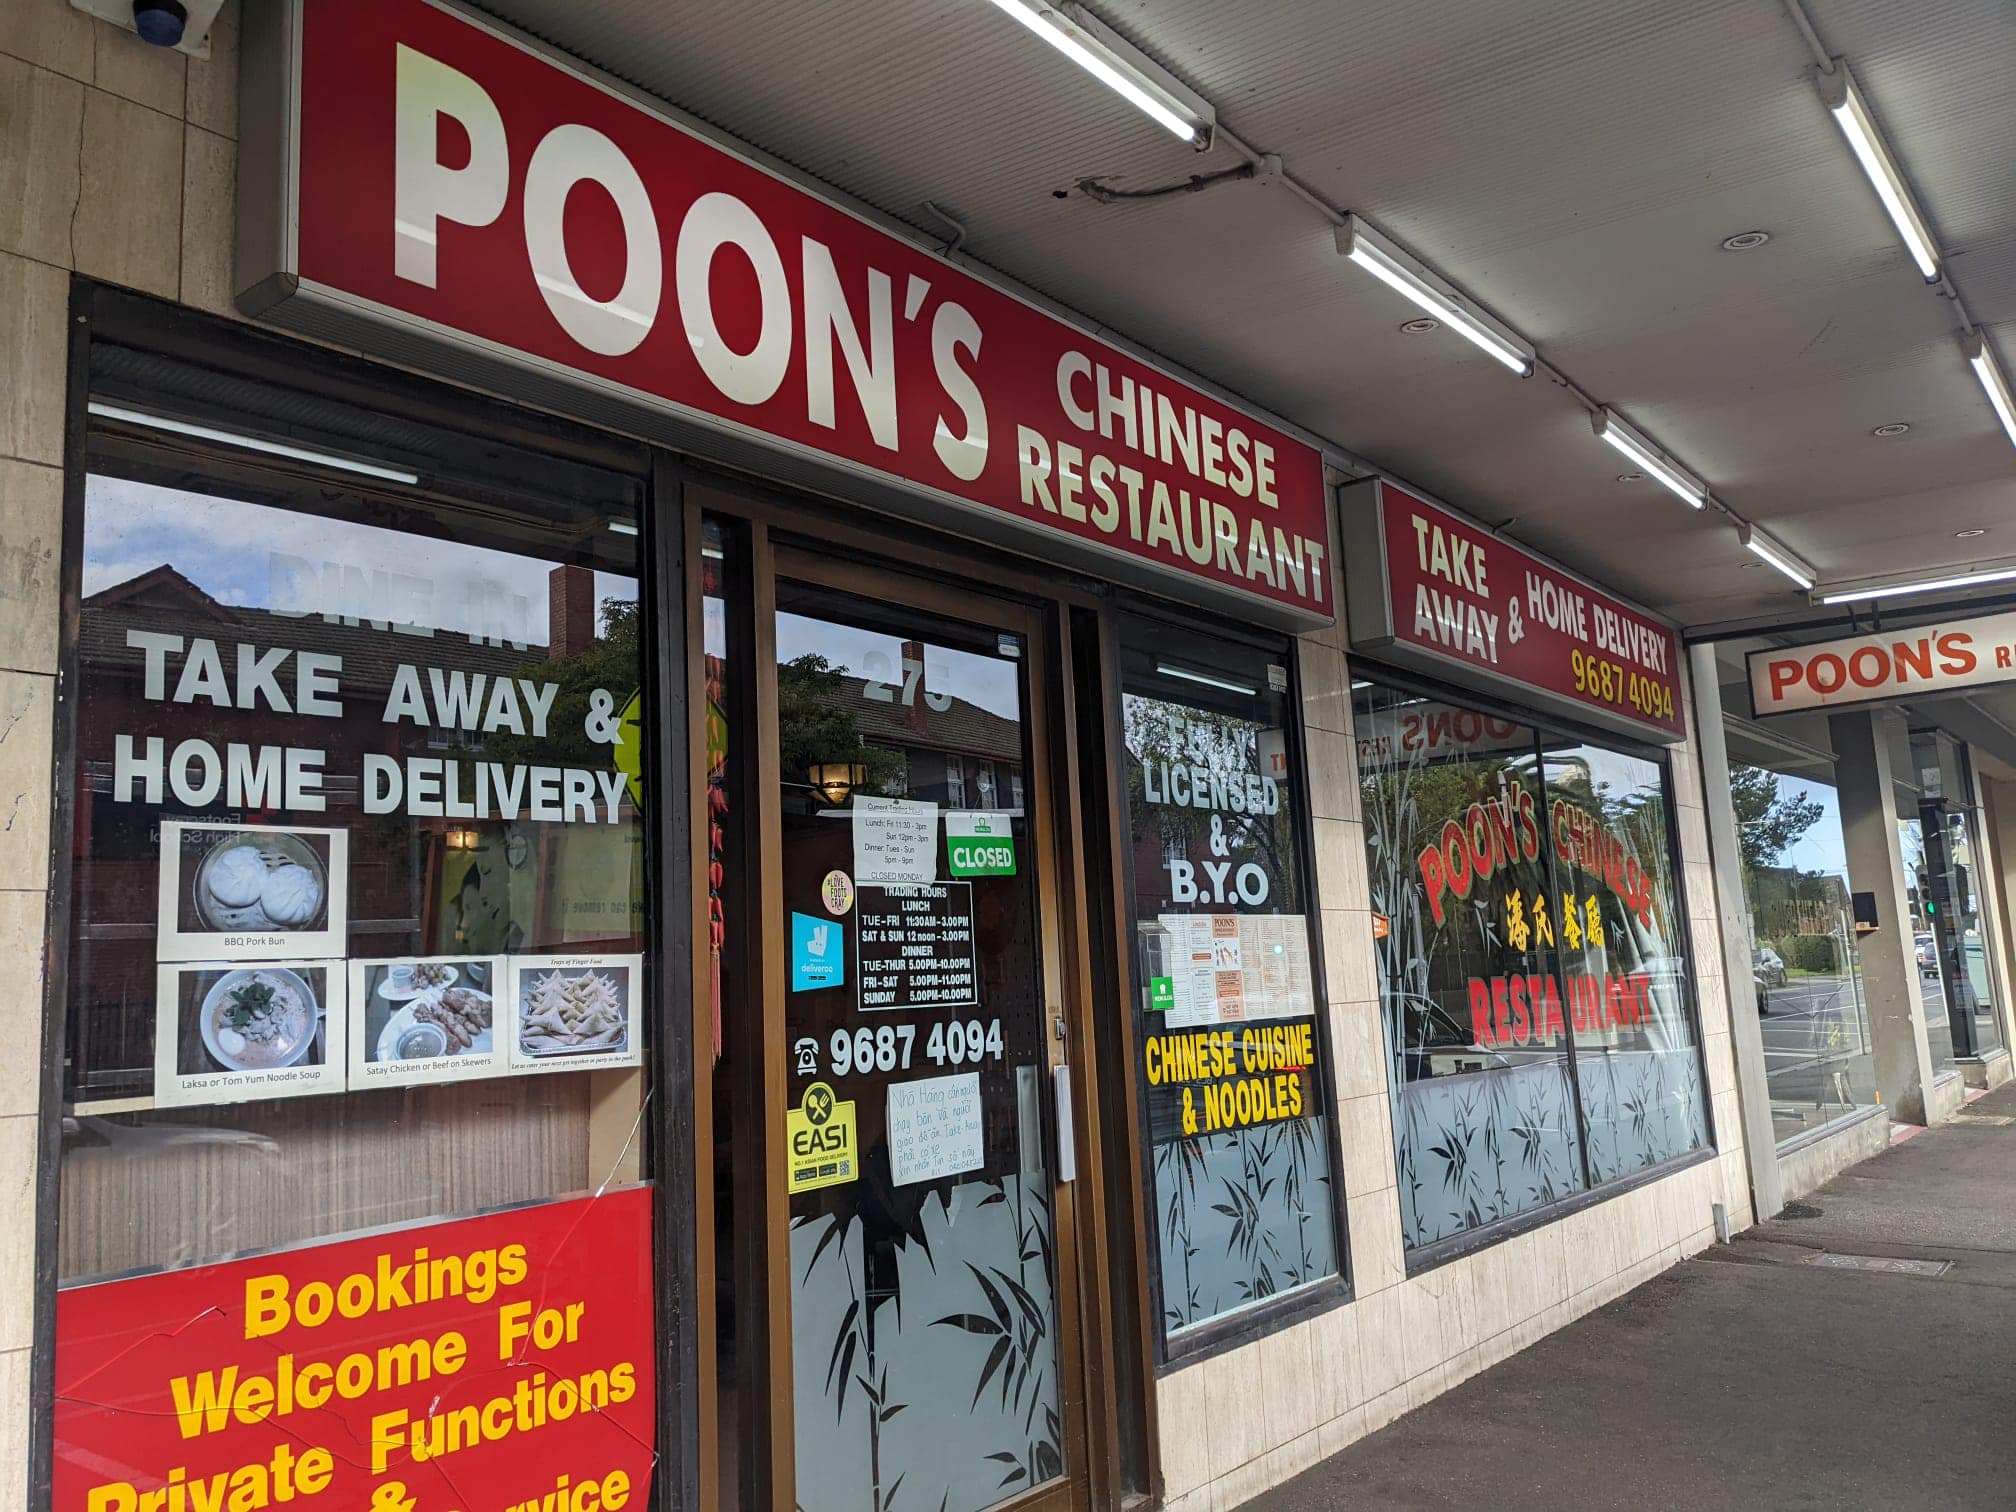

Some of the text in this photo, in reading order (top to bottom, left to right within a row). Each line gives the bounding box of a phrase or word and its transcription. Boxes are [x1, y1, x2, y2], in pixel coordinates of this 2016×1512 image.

[394, 42, 988, 480] POON'S
[1056, 350, 1279, 509] CHINESE
[1017, 424, 1324, 602] RESTAURANT
[1411, 514, 1489, 598] TAKE
[1414, 584, 1525, 664] AWAY &
[1526, 570, 1667, 676] HOME DELIVERY
[126, 629, 625, 745] TAKE AWAY &
[863, 650, 953, 712] 275
[1571, 649, 1675, 722] 9687 4094
[1769, 630, 1977, 700] POON'S
[1169, 717, 1248, 770] FULLY
[114, 734, 628, 825] HOME DELIVERY
[1143, 760, 1280, 816] LICENSED
[953, 847, 1012, 868] CLOSED
[1210, 814, 1230, 857] &
[1418, 781, 1539, 929] POON'S
[1552, 800, 1652, 929] CHINESE
[831, 888, 847, 898] FOOTS
[871, 872, 923, 880] CLOSED MONDAY
[884, 887, 947, 898] TRADING HOURS
[902, 900, 930, 911] LUNCH
[1170, 859, 1269, 906] B.Y.O
[224, 936, 285, 946] BBQ Pork Bun
[862, 931, 878, 942] SAT
[880, 931, 886, 942] &
[888, 931, 905, 942] SUN
[907, 931, 916, 942] 12
[918, 933, 936, 942] noon
[902, 945, 934, 957] DINNER
[864, 991, 896, 1004] SUNDAY
[1467, 972, 1652, 1050] RESTAURANT
[366, 1067, 388, 1075] Satay
[390, 1063, 420, 1073] Chicken
[432, 1061, 449, 1069] Beef
[461, 1057, 492, 1068] Skewers
[830, 1018, 1004, 1076] 9687 4094
[1146, 1023, 1314, 1086] CHINESE CUISINE
[182, 1070, 320, 1089] Laksa or Tom Yum Noodle Soup
[1182, 1072, 1302, 1135] & NOODLES
[793, 1123, 847, 1156] EASI
[245, 1243, 528, 1339] Bookings
[170, 1300, 585, 1440] Welcome For
[370, 1360, 636, 1478] Functions
